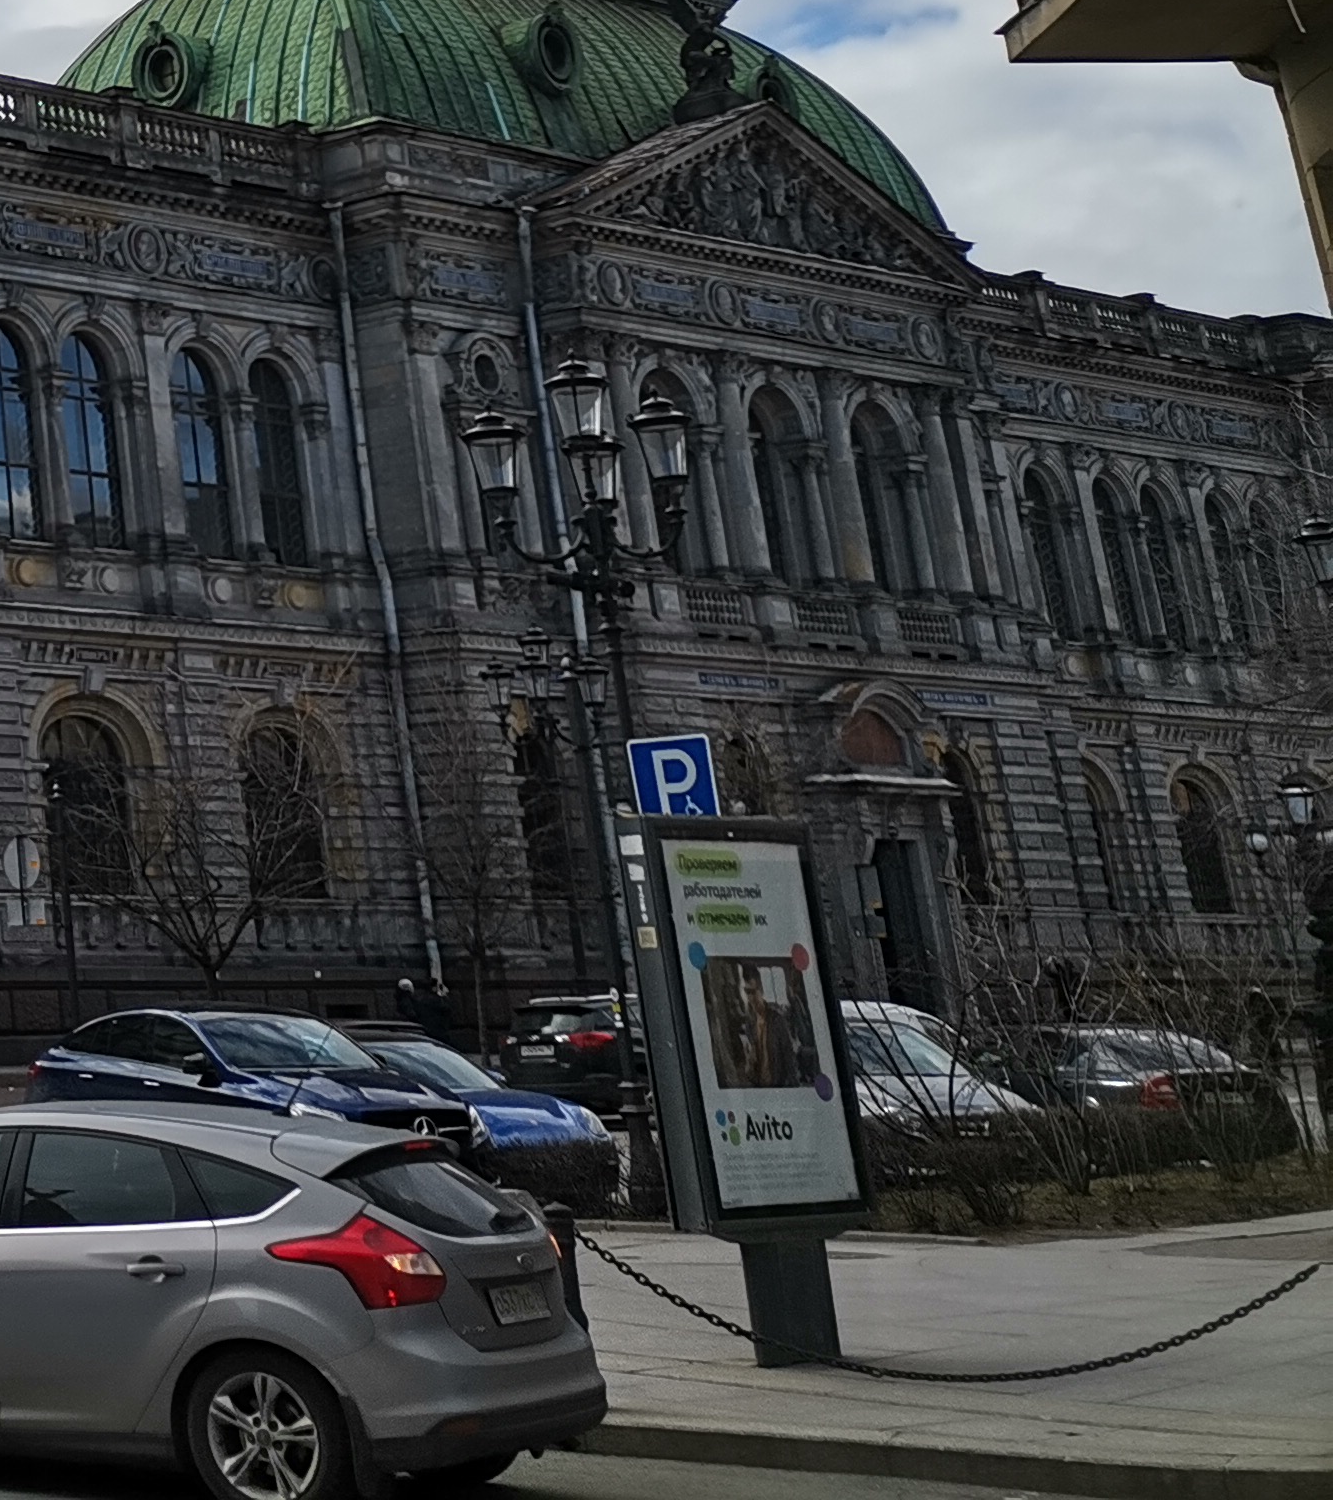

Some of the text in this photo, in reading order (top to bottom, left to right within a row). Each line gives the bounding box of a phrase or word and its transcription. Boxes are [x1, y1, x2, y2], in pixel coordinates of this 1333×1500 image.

[651, 748, 697, 816] P
[676, 853, 738, 874] Проверяем
[682, 881, 762, 901] работодателей
[686, 912, 769, 926] и отмечаем их
[745, 1112, 794, 1142] Avito
